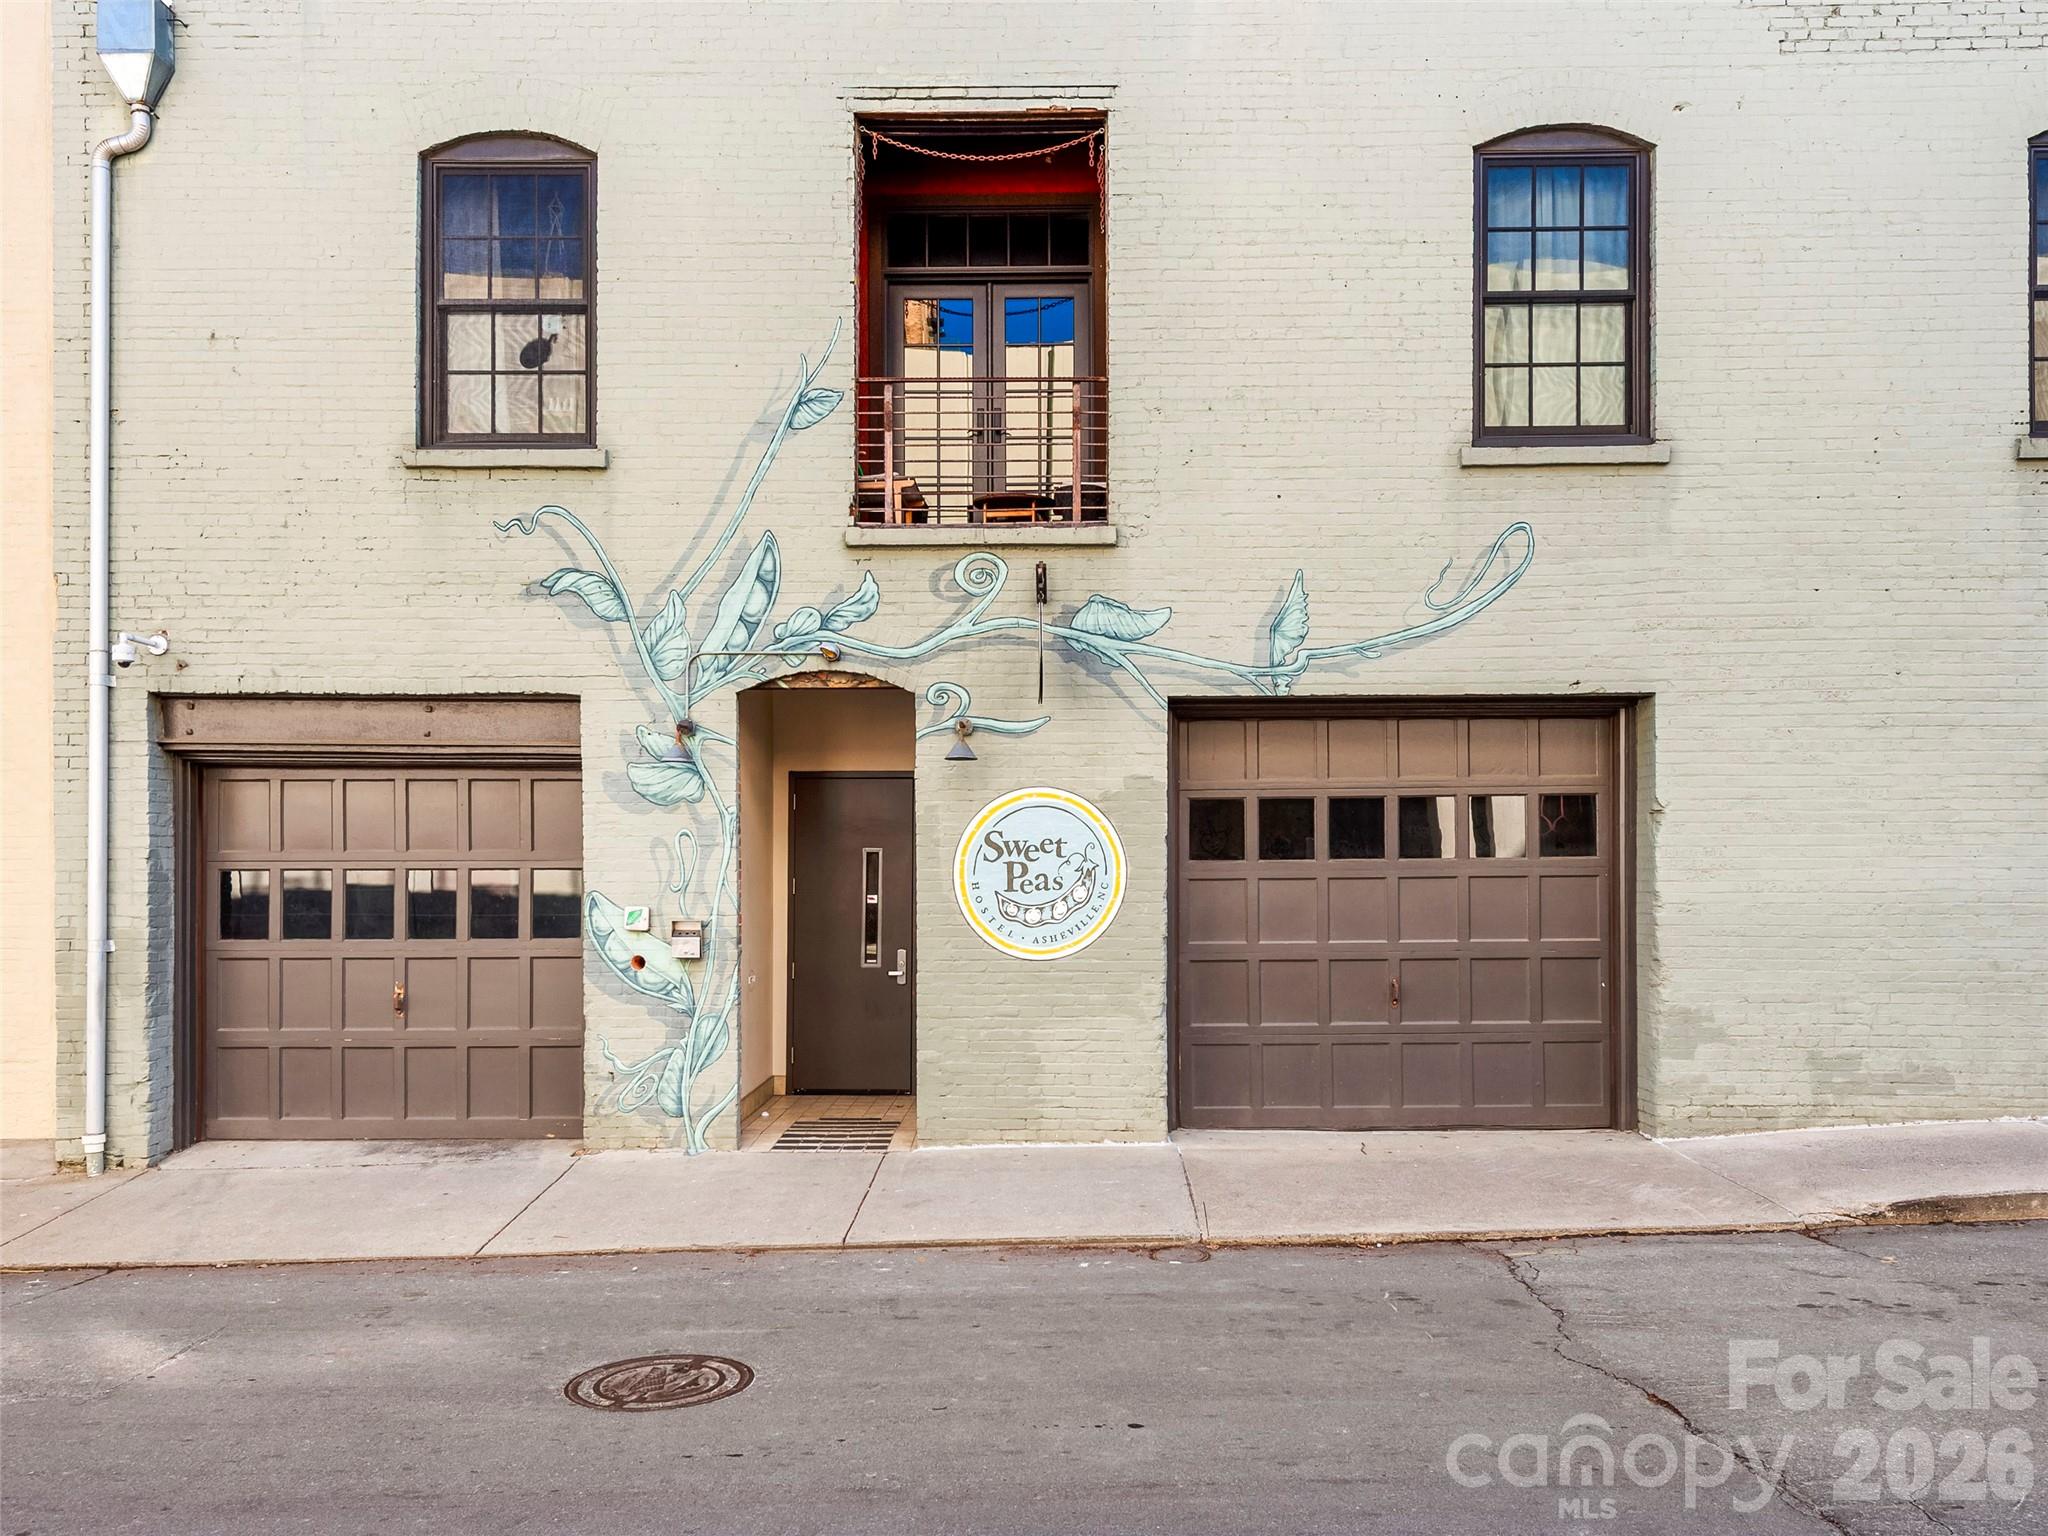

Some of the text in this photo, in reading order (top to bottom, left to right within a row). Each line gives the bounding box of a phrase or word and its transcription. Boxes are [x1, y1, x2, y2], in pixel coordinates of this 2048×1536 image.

[983, 830, 1068, 862] Sweet
[1003, 860, 1064, 895] Peas
[971, 881, 1014, 939] HOSTEL
